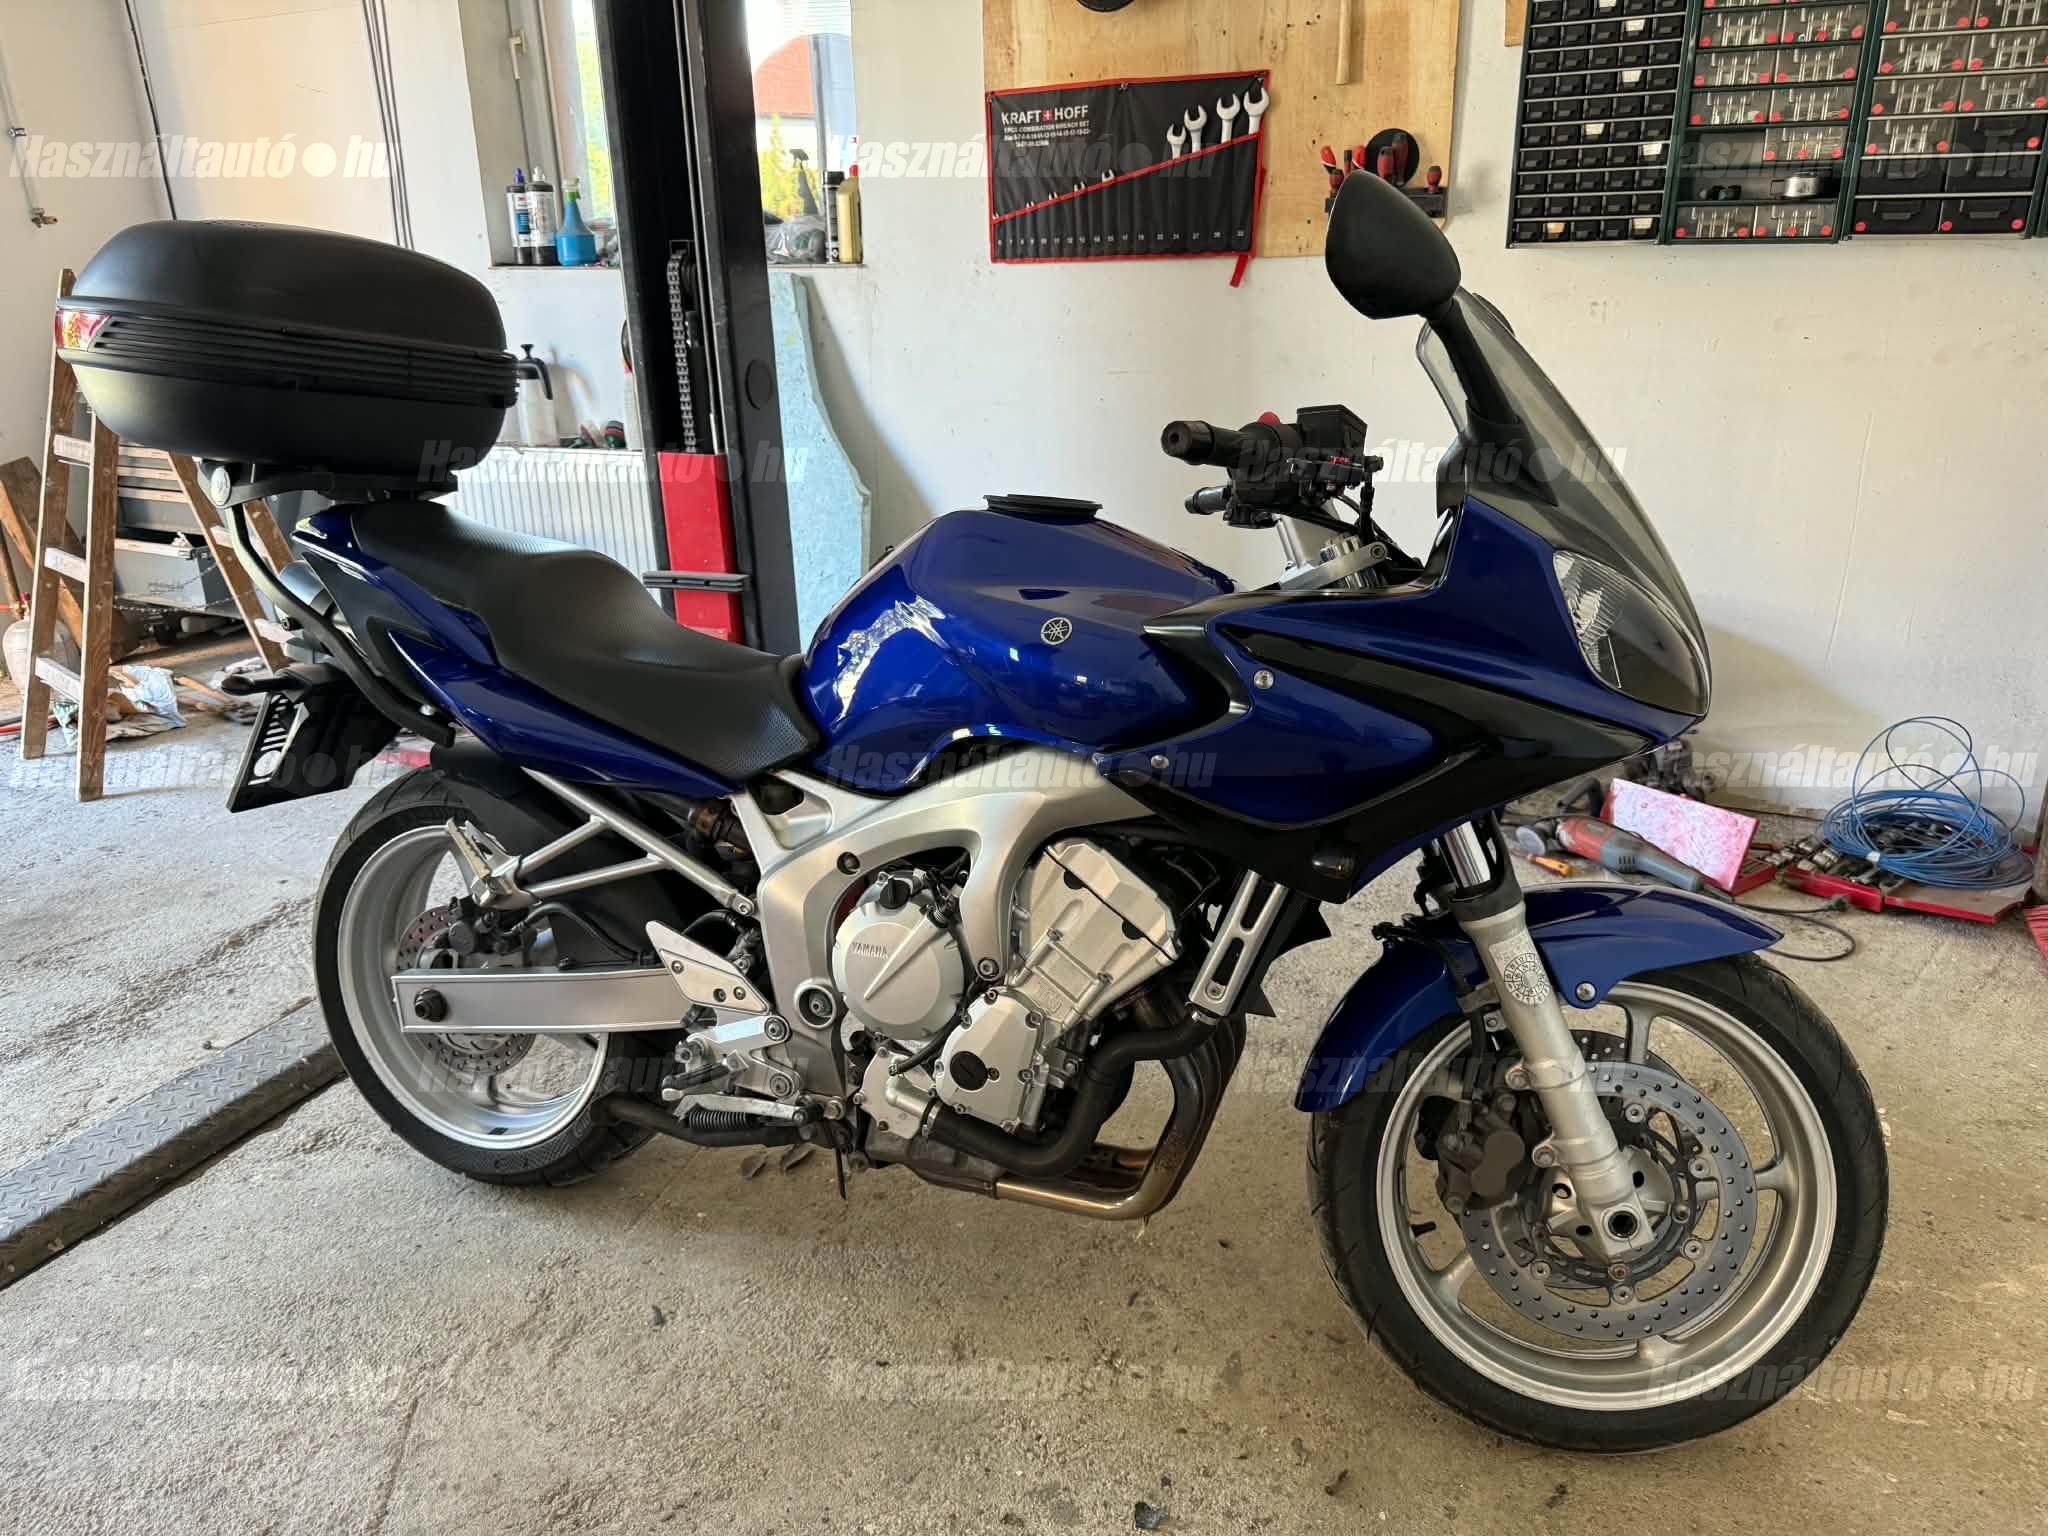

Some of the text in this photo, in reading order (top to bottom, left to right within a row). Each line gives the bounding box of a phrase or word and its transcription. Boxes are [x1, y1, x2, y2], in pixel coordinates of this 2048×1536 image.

[1001, 105, 1089, 125] KRAFT HOFF
[851, 942, 888, 959] YAMAHA
